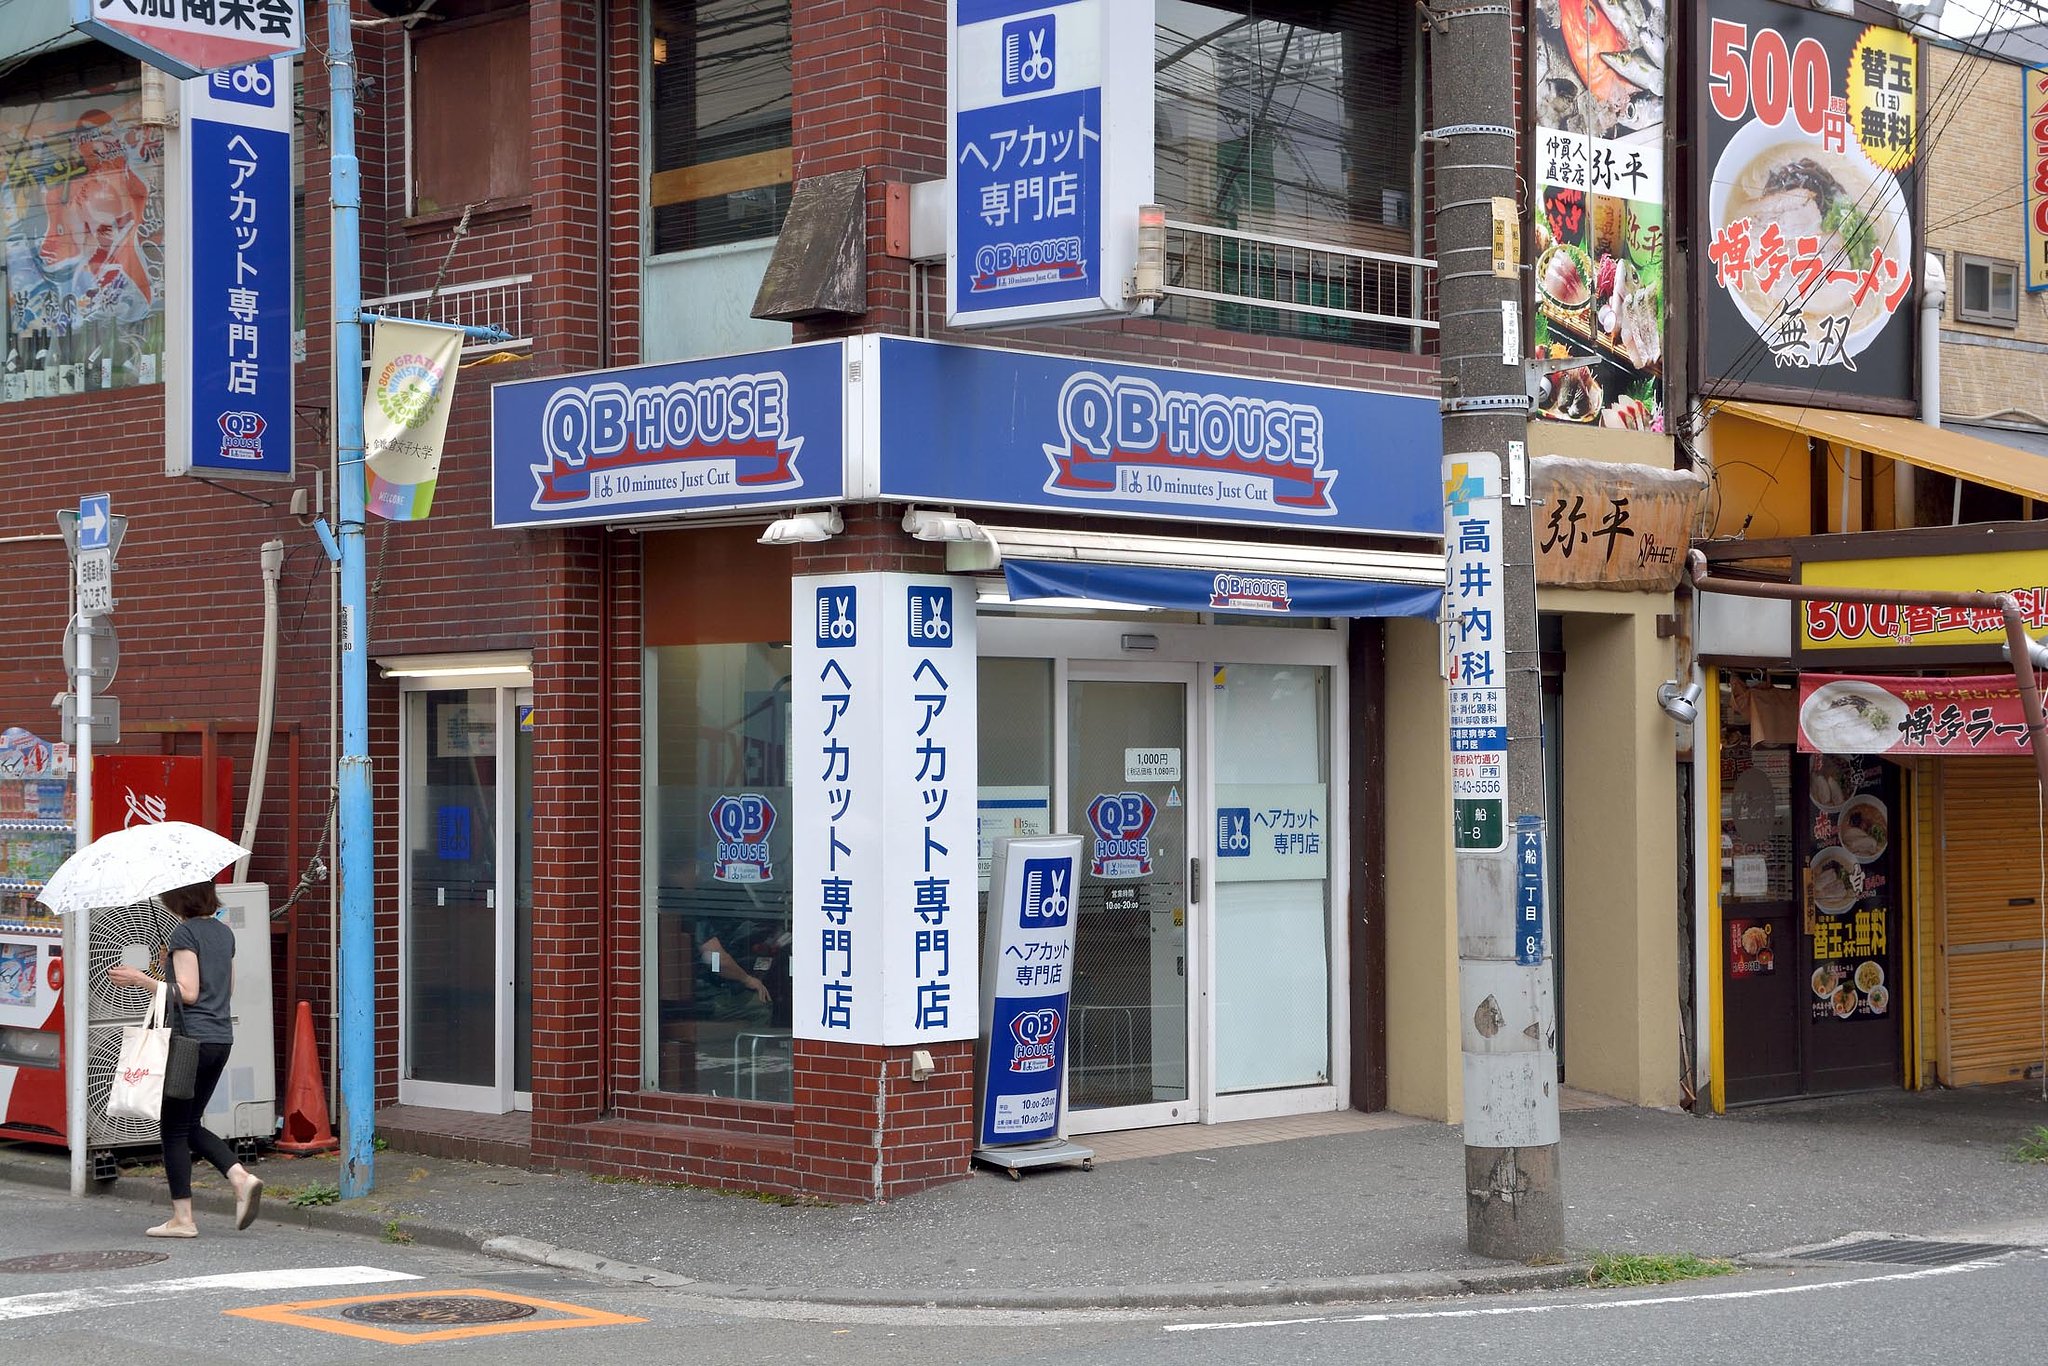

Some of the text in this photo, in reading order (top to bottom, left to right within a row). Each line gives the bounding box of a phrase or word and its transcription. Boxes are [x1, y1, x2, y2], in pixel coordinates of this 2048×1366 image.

[1861, 47, 1913, 95] 替玉
[959, 116, 1100, 173] ヘアカット
[1546, 136, 1586, 163] 仲買人
[1861, 109, 1914, 155] 無料
[1546, 163, 1586, 187] 直営店
[1592, 144, 1649, 196] 弥平
[979, 171, 1078, 227] 専門店
[226, 133, 260, 396] ヘアカット専門店
[975, 237, 1082, 278] QB HOUSE
[1709, 218, 1912, 314] 博多ラーメン
[1771, 298, 1857, 373] 無双
[225, 414, 257, 438] QB
[547, 373, 786, 466] QB HOUSE
[1066, 376, 1322, 465] QB HOUSE
[224, 437, 261, 449] HOUSE
[616, 467, 731, 493] 10 minutes Just Cut
[1146, 474, 1269, 502] 10 minutes Just Cut
[1540, 496, 1635, 564] 弥平
[1215, 575, 1287, 597] QB HOUSE
[1459, 519, 1494, 686] 高井内科
[1137, 753, 1168, 766] 1,000円
[721, 800, 763, 840] QB
[1099, 795, 1143, 839] QB
[1254, 808, 1319, 830] ヘアカット
[1458, 826, 1481, 839] 1-8
[719, 843, 767, 860] HOUSE
[820, 658, 853, 1030] ヘアカット専門店
[912, 658, 951, 1030] ヘアカット専門店
[1096, 839, 1148, 857] HOUSE
[1274, 832, 1321, 855] 専門店
[1525, 831, 1537, 954] 大船一丁目 8
[1005, 940, 1070, 961] ヘアカット
[1015, 962, 1062, 987] 専門店
[1020, 1012, 1054, 1043] QB
[1016, 1043, 1055, 1058] HOUSE
